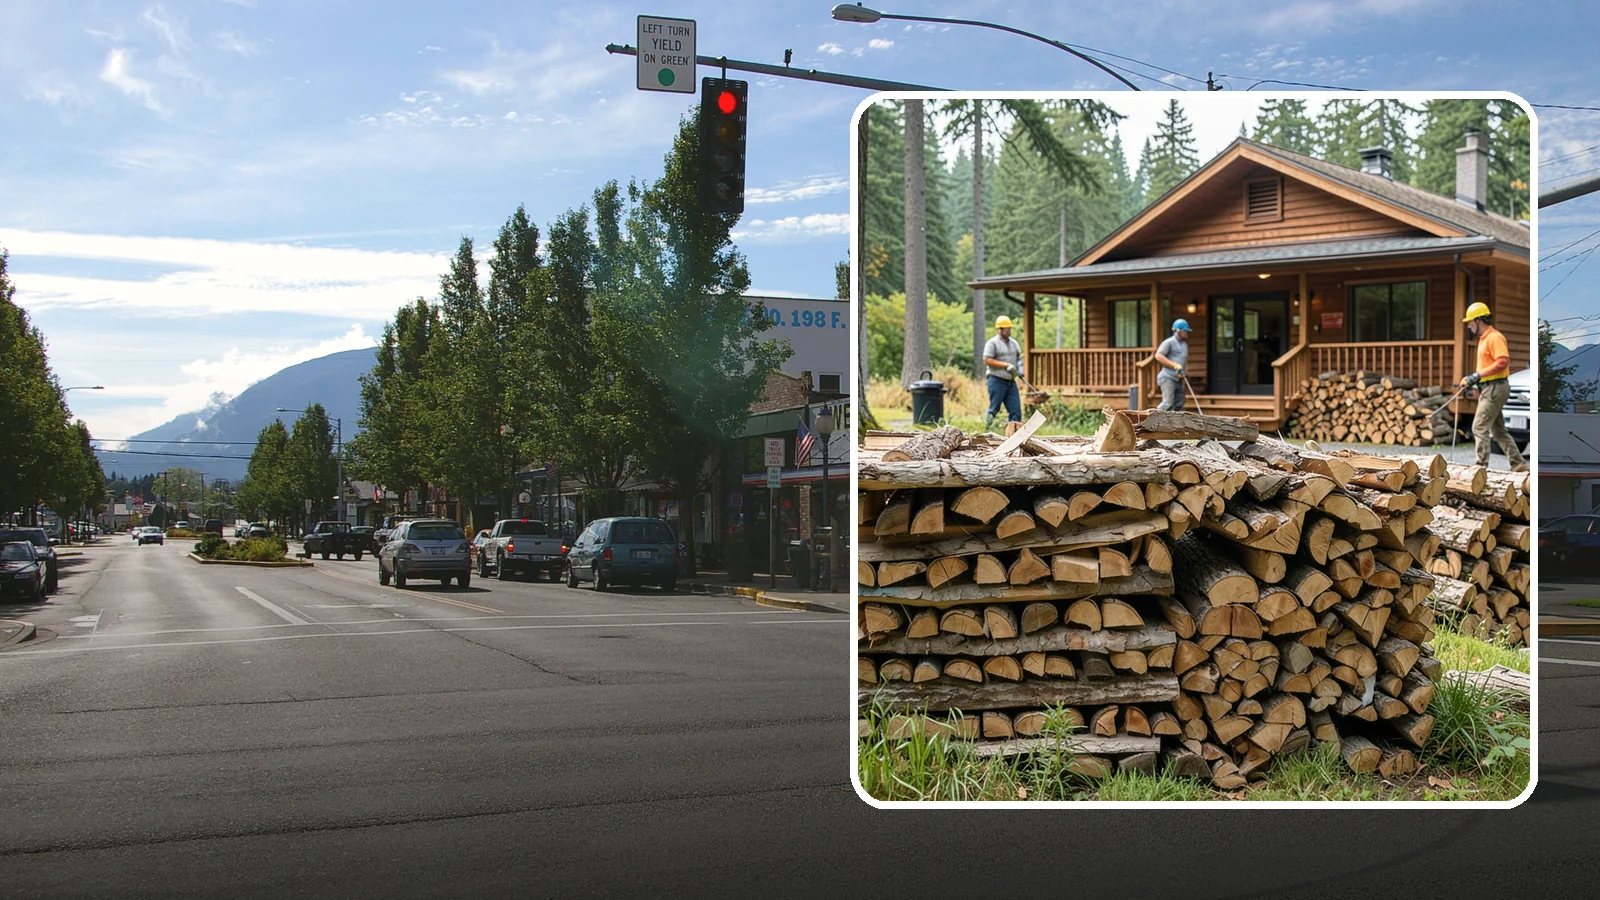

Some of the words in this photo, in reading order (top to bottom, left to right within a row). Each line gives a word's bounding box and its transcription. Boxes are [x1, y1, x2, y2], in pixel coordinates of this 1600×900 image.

[643, 24, 663, 34] LEFT
[668, 26, 690, 37] TURN
[652, 38, 682, 52] YIELD
[644, 53, 656, 63] ON
[661, 55, 688, 66] GREEN
[791, 309, 826, 328] 198
[831, 311, 847, 329] F.
